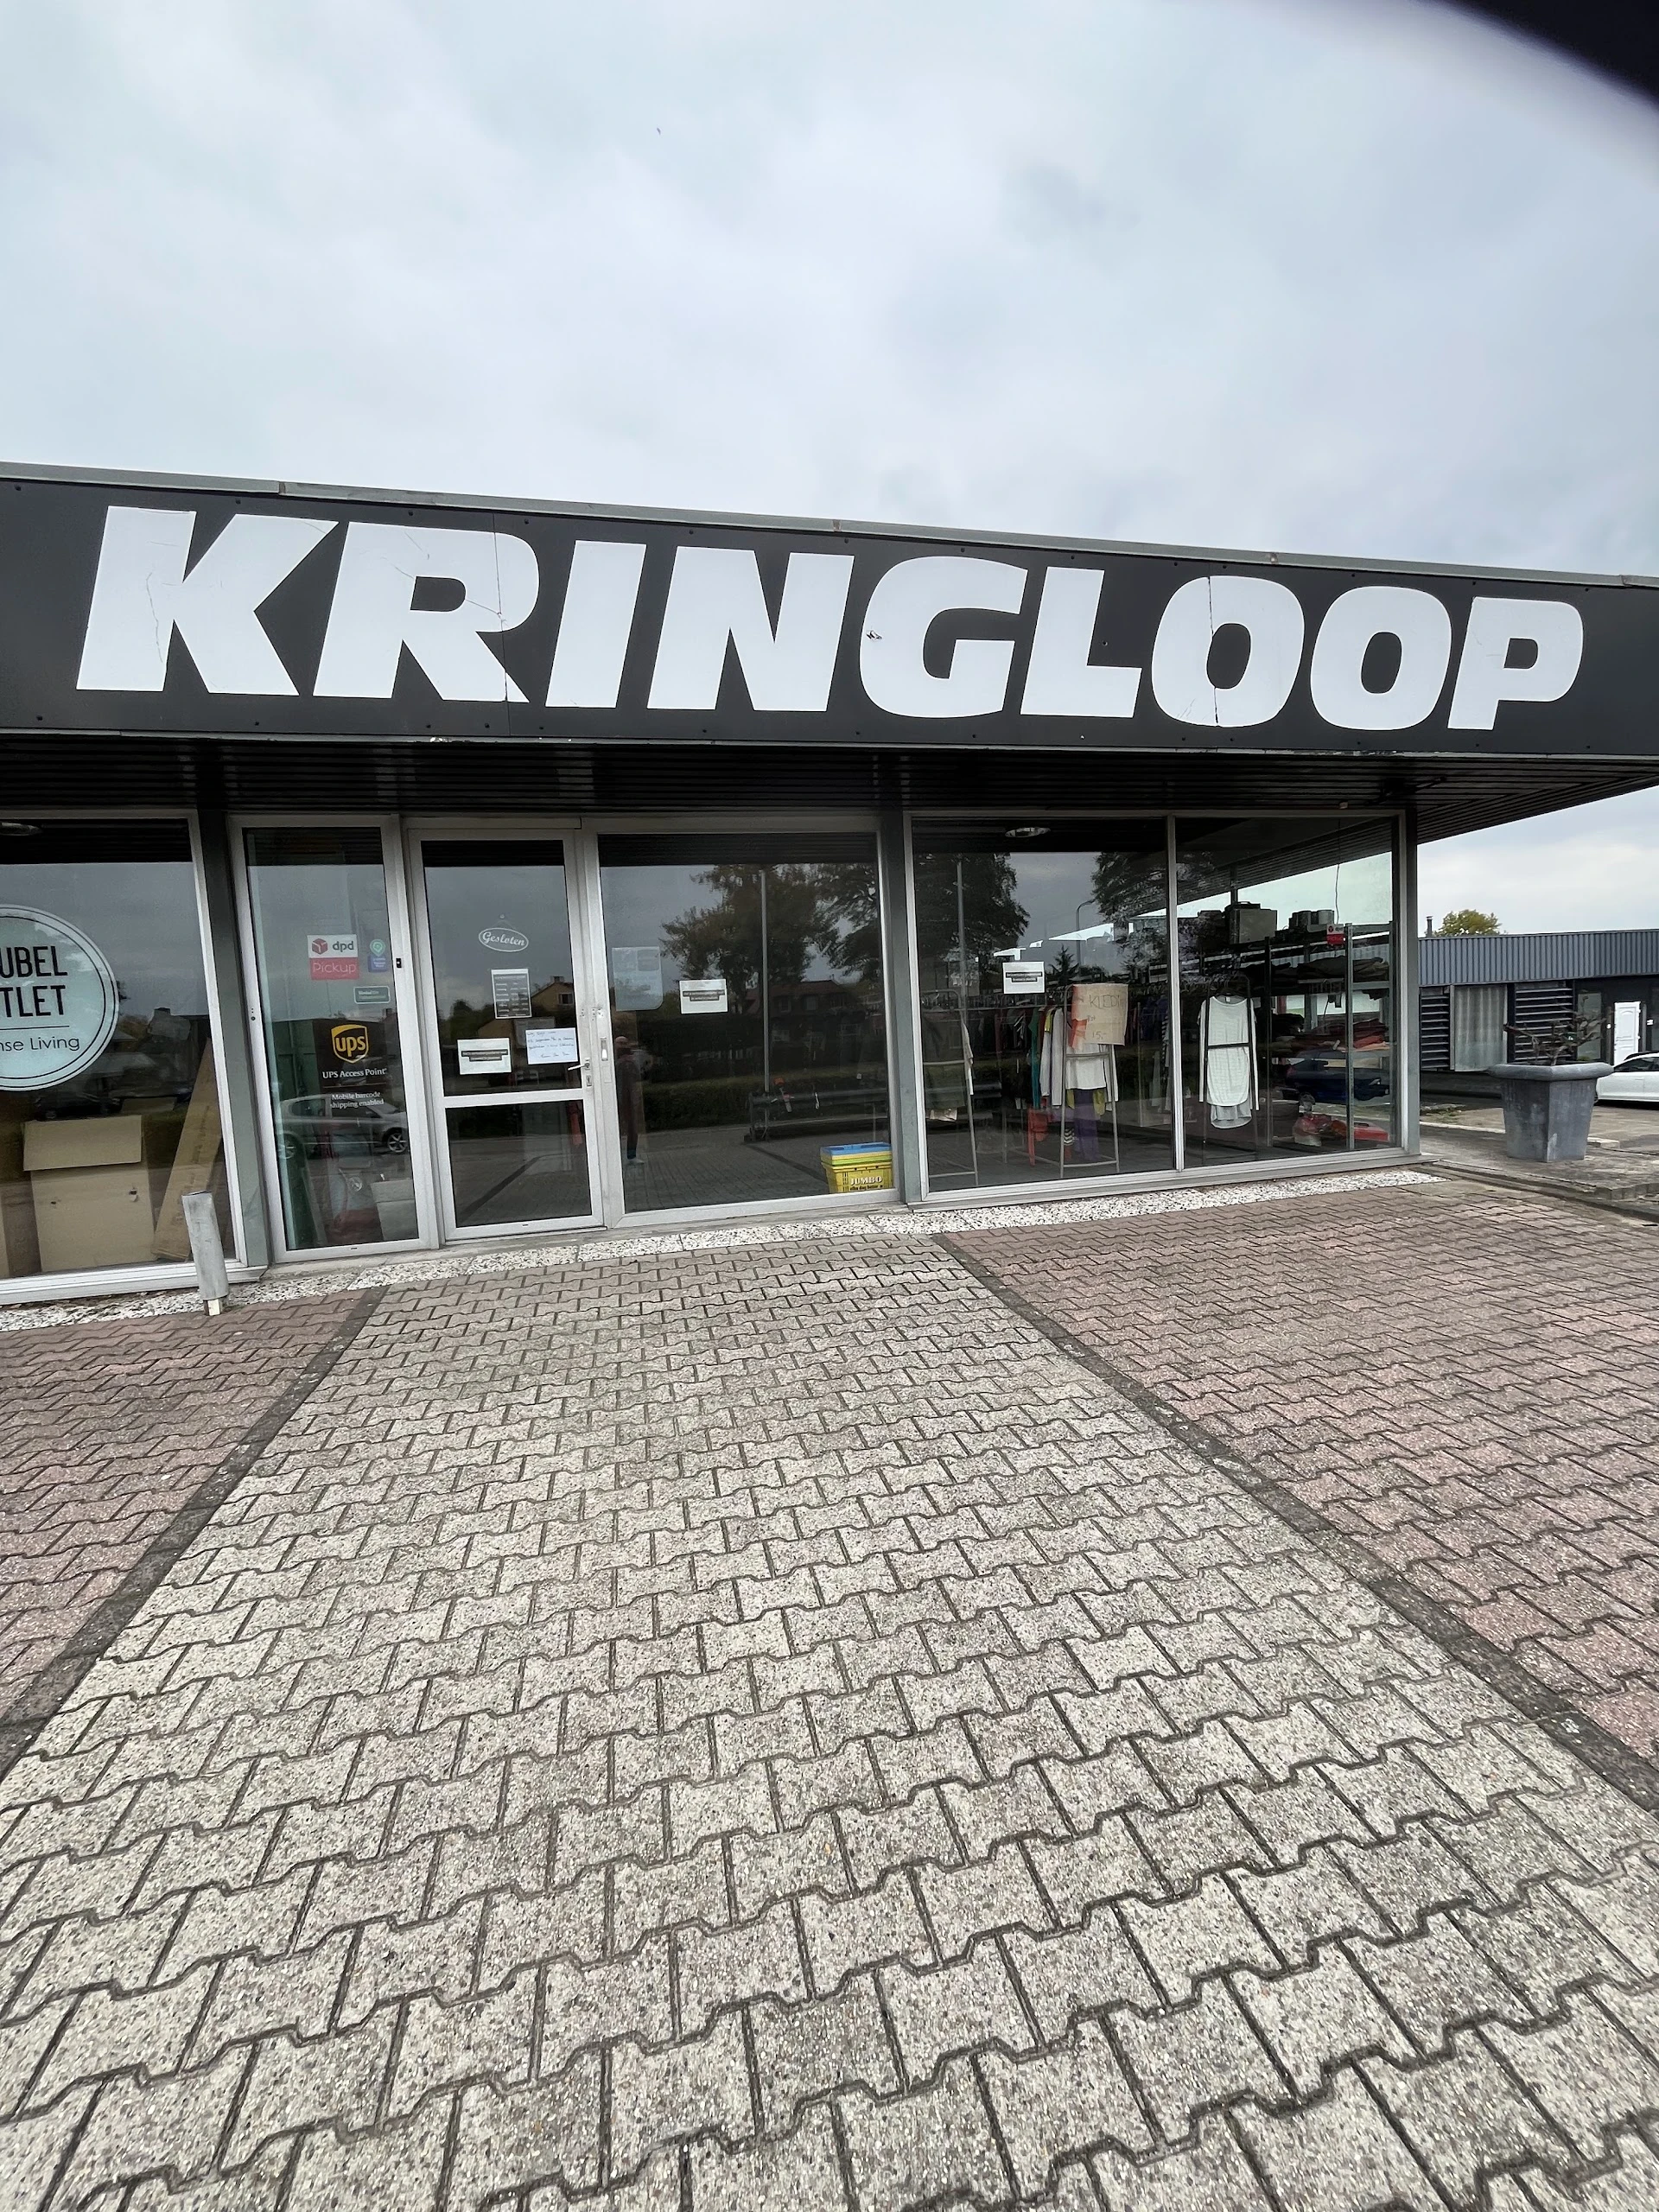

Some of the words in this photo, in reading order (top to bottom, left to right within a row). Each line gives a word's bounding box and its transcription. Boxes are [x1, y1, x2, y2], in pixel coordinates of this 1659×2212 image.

[75, 505, 1585, 731] KRINGLOOP
[482, 931, 525, 946] Gesloten
[332, 941, 354, 952] dpd
[312, 963, 357, 974] Pickup
[29, 1036, 80, 1052] Living
[335, 1036, 366, 1058] ups
[322, 1071, 339, 1079] UPS
[330, 1101, 359, 1109] shipping
[850, 1176, 882, 1185] JUMBO
